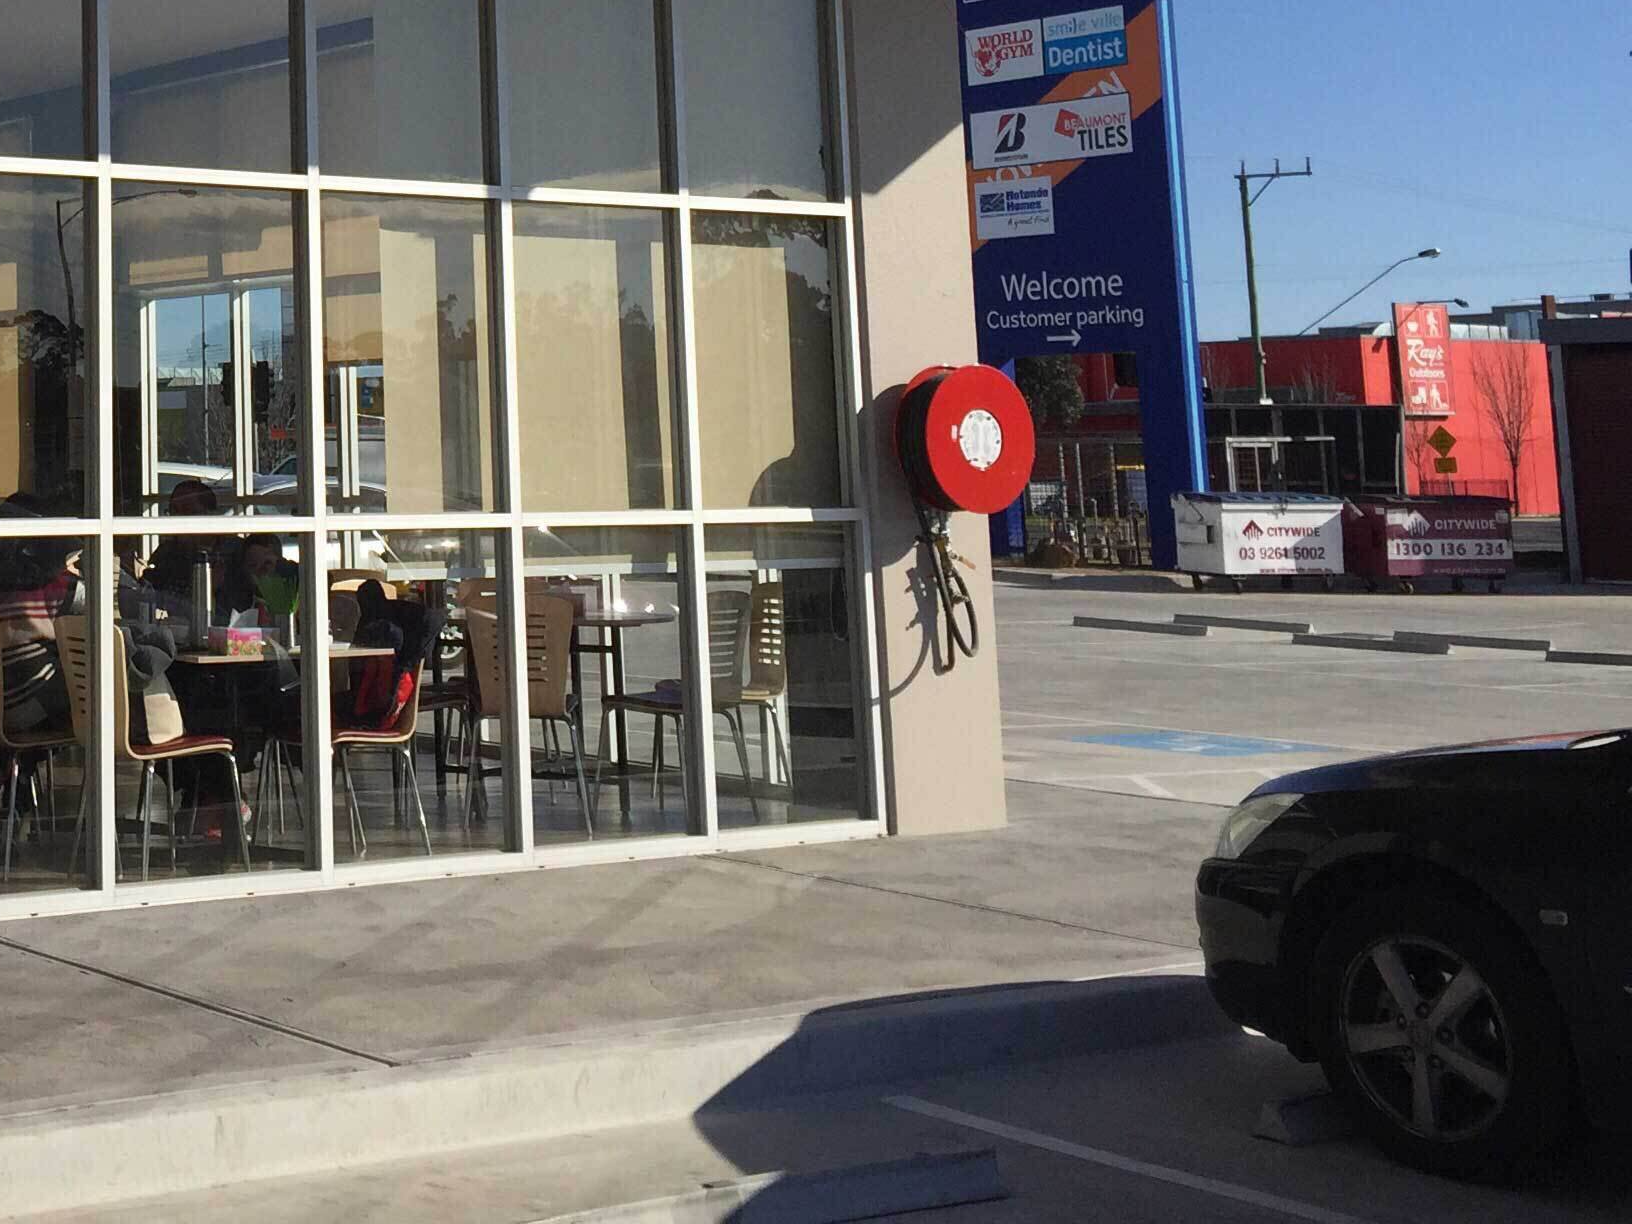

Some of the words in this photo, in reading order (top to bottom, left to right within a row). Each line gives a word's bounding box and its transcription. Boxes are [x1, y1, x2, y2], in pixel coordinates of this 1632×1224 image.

[1091, 13, 1122, 29] ville
[977, 29, 1033, 50] WORLD
[1000, 42, 1034, 61] GYM
[1048, 36, 1124, 68] Dentist
[1064, 112, 1127, 131] BEAUMONT
[1077, 125, 1129, 151] TILES
[1001, 271, 1123, 302] Welcome
[987, 310, 1072, 329] Customer
[1076, 305, 1145, 329] parking
[1405, 338, 1445, 367] Ray's
[1408, 367, 1446, 379] Outdoors
[1266, 526, 1321, 537] CITYWIDE
[1434, 519, 1497, 531] CITYWIDE
[1239, 546, 1256, 561] 03
[1259, 546, 1289, 561] 9261
[1293, 546, 1326, 561] 5002
[1396, 542, 1433, 556] 1300
[1441, 542, 1467, 556] 136
[1475, 542, 1505, 556] 234
